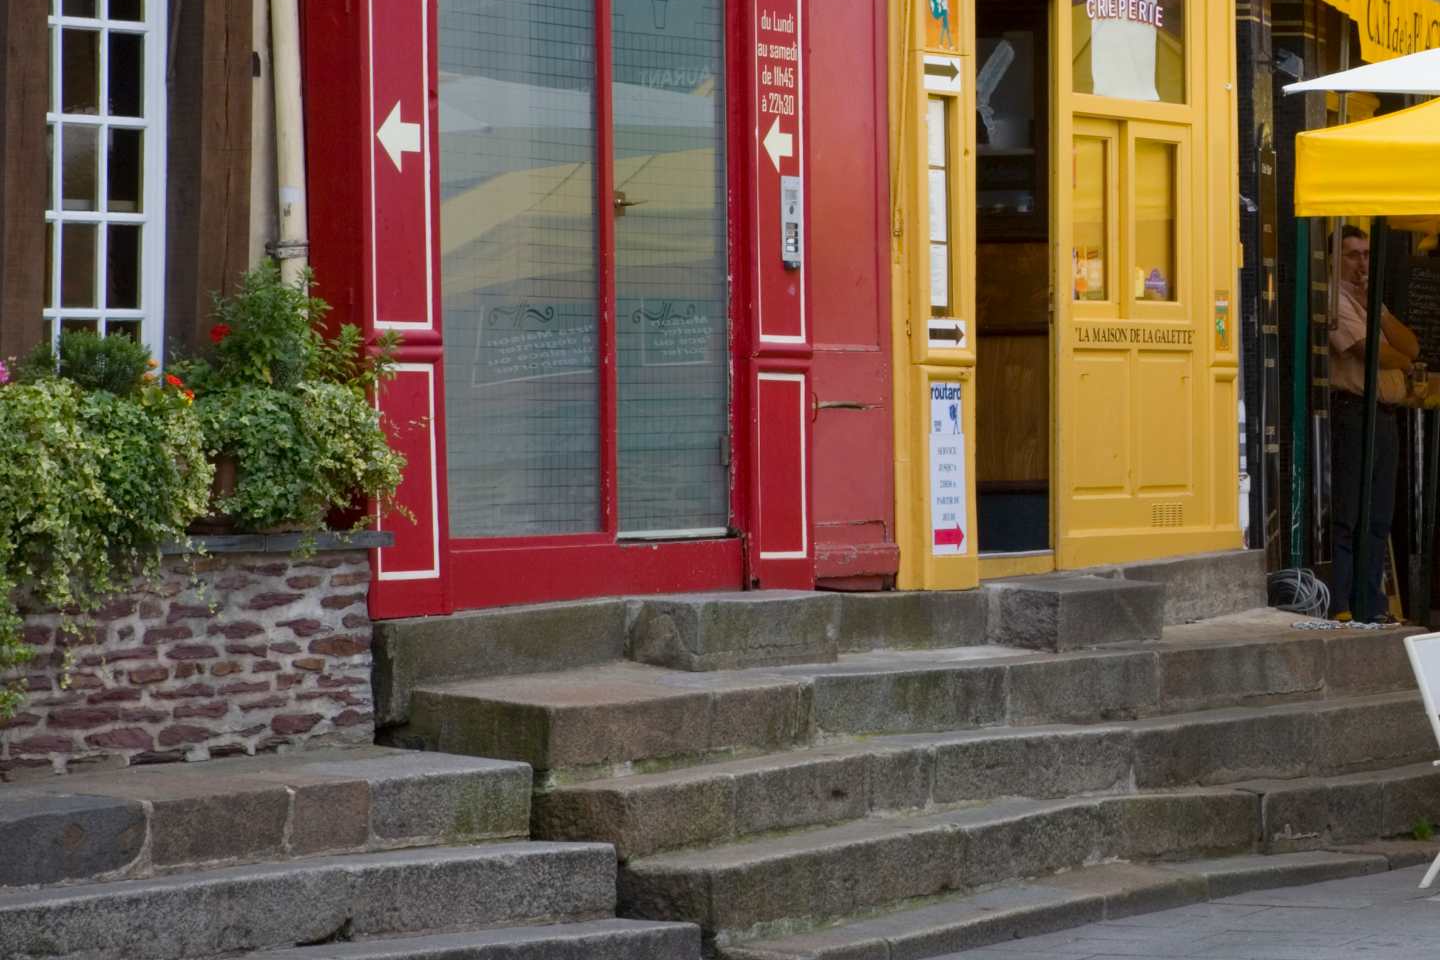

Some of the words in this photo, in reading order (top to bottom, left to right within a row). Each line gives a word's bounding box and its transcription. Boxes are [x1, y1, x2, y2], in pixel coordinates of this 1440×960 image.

[761, 9, 772, 31] du
[773, 10, 794, 33] Lundi
[757, 43, 768, 57] au
[769, 41, 799, 61] samedi
[762, 64, 772, 86] de
[774, 66, 794, 89] 11h45
[761, 95, 767, 113] à
[768, 92, 794, 117] 22h30
[1092, 327, 1128, 343] MAISON
[1130, 328, 1141, 344] DE
[1142, 328, 1155, 344] LA
